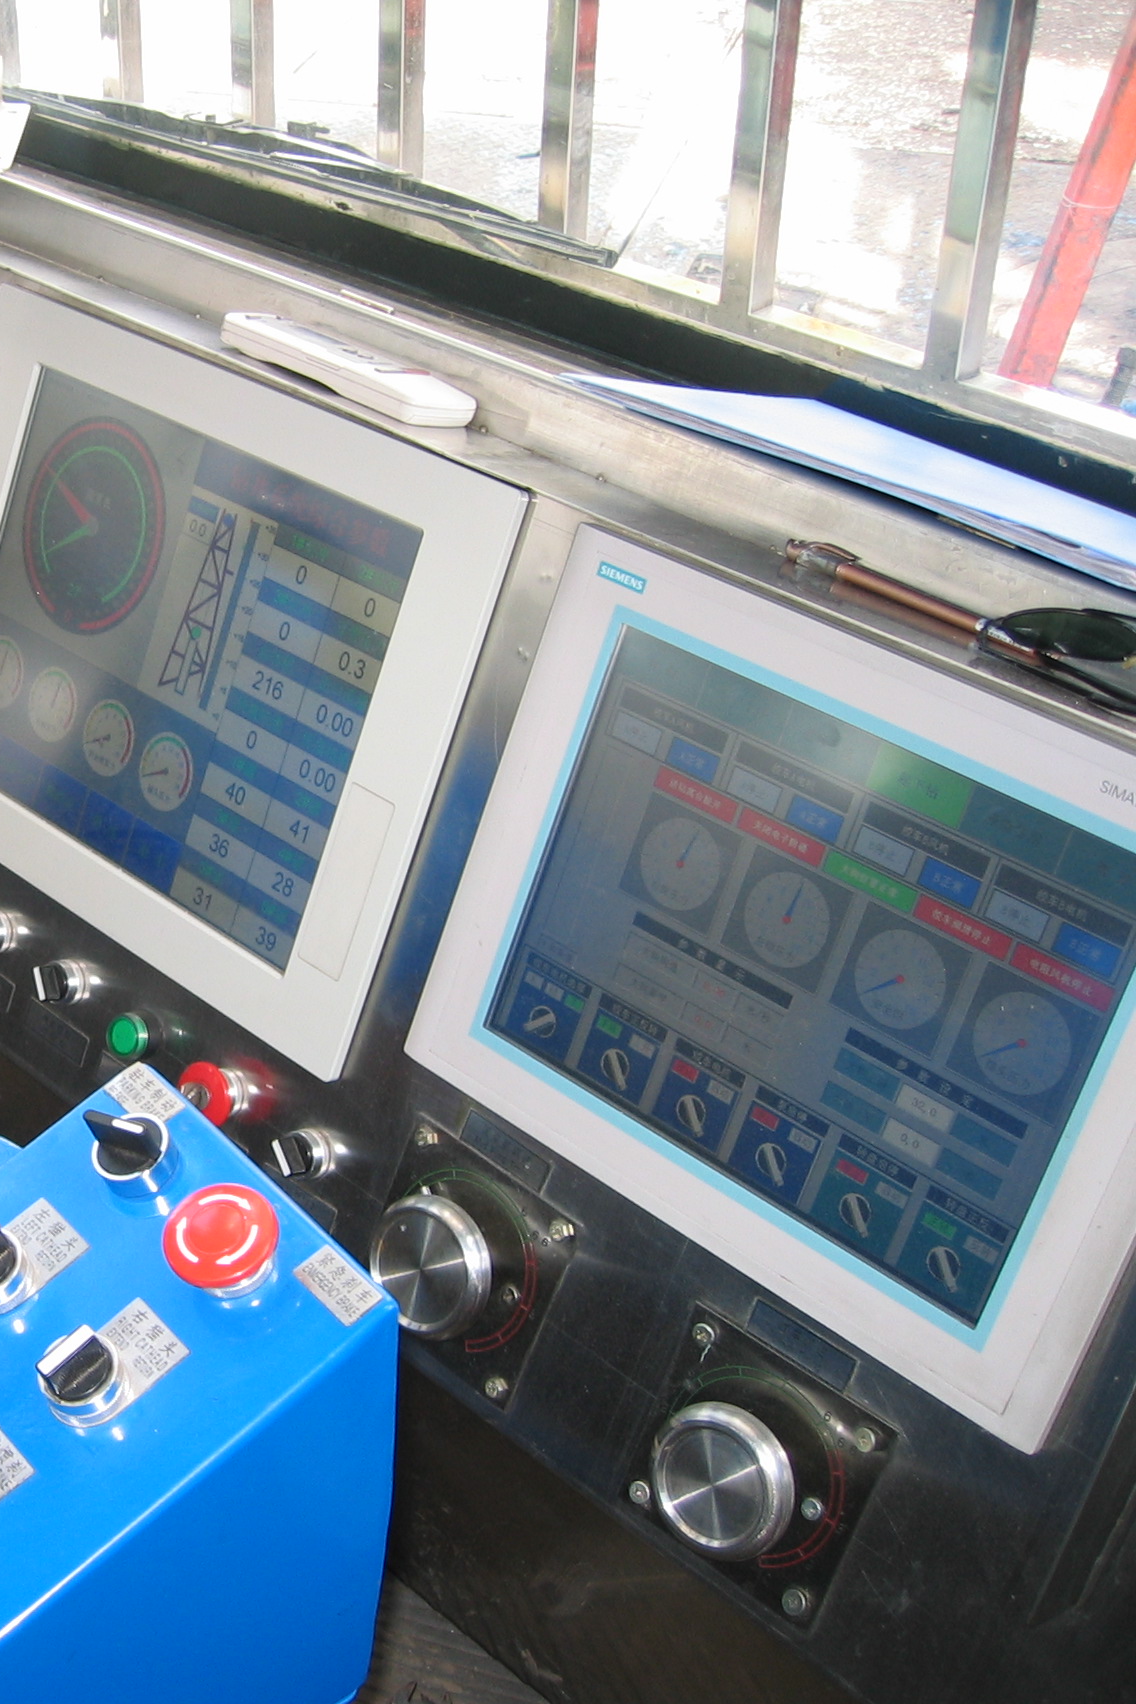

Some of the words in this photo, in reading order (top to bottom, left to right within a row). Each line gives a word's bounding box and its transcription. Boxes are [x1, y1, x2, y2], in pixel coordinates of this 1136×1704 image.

[295, 565, 307, 585] 0
[599, 563, 645, 592] SIEMENS
[364, 597, 376, 618] 0
[278, 621, 291, 641] 0
[338, 651, 366, 679] 0.3
[251, 670, 284, 700] 216
[316, 704, 354, 738] 0.00
[246, 730, 258, 750] 0
[299, 759, 336, 793] 0.00
[225, 782, 246, 806] 40
[209, 833, 230, 858] 36
[289, 820, 310, 844] 41
[271, 871, 295, 897] 28
[192, 887, 213, 911] 31
[255, 926, 277, 951] 39
[117, 1076, 146, 1104] PARKING
[21, 1217, 41, 1235] LEFT
[35, 1231, 68, 1263] CATHEAD
[33, 1208, 80, 1252] 左猫头
[302, 1263, 342, 1299] EMERGENCY
[336, 1295, 360, 1317] BRAKE
[317, 1253, 374, 1306] 紧急刹车
[115, 1316, 141, 1341] RIGHT
[134, 1337, 169, 1372] CATHEAD
[131, 1310, 177, 1358] 右猫头
